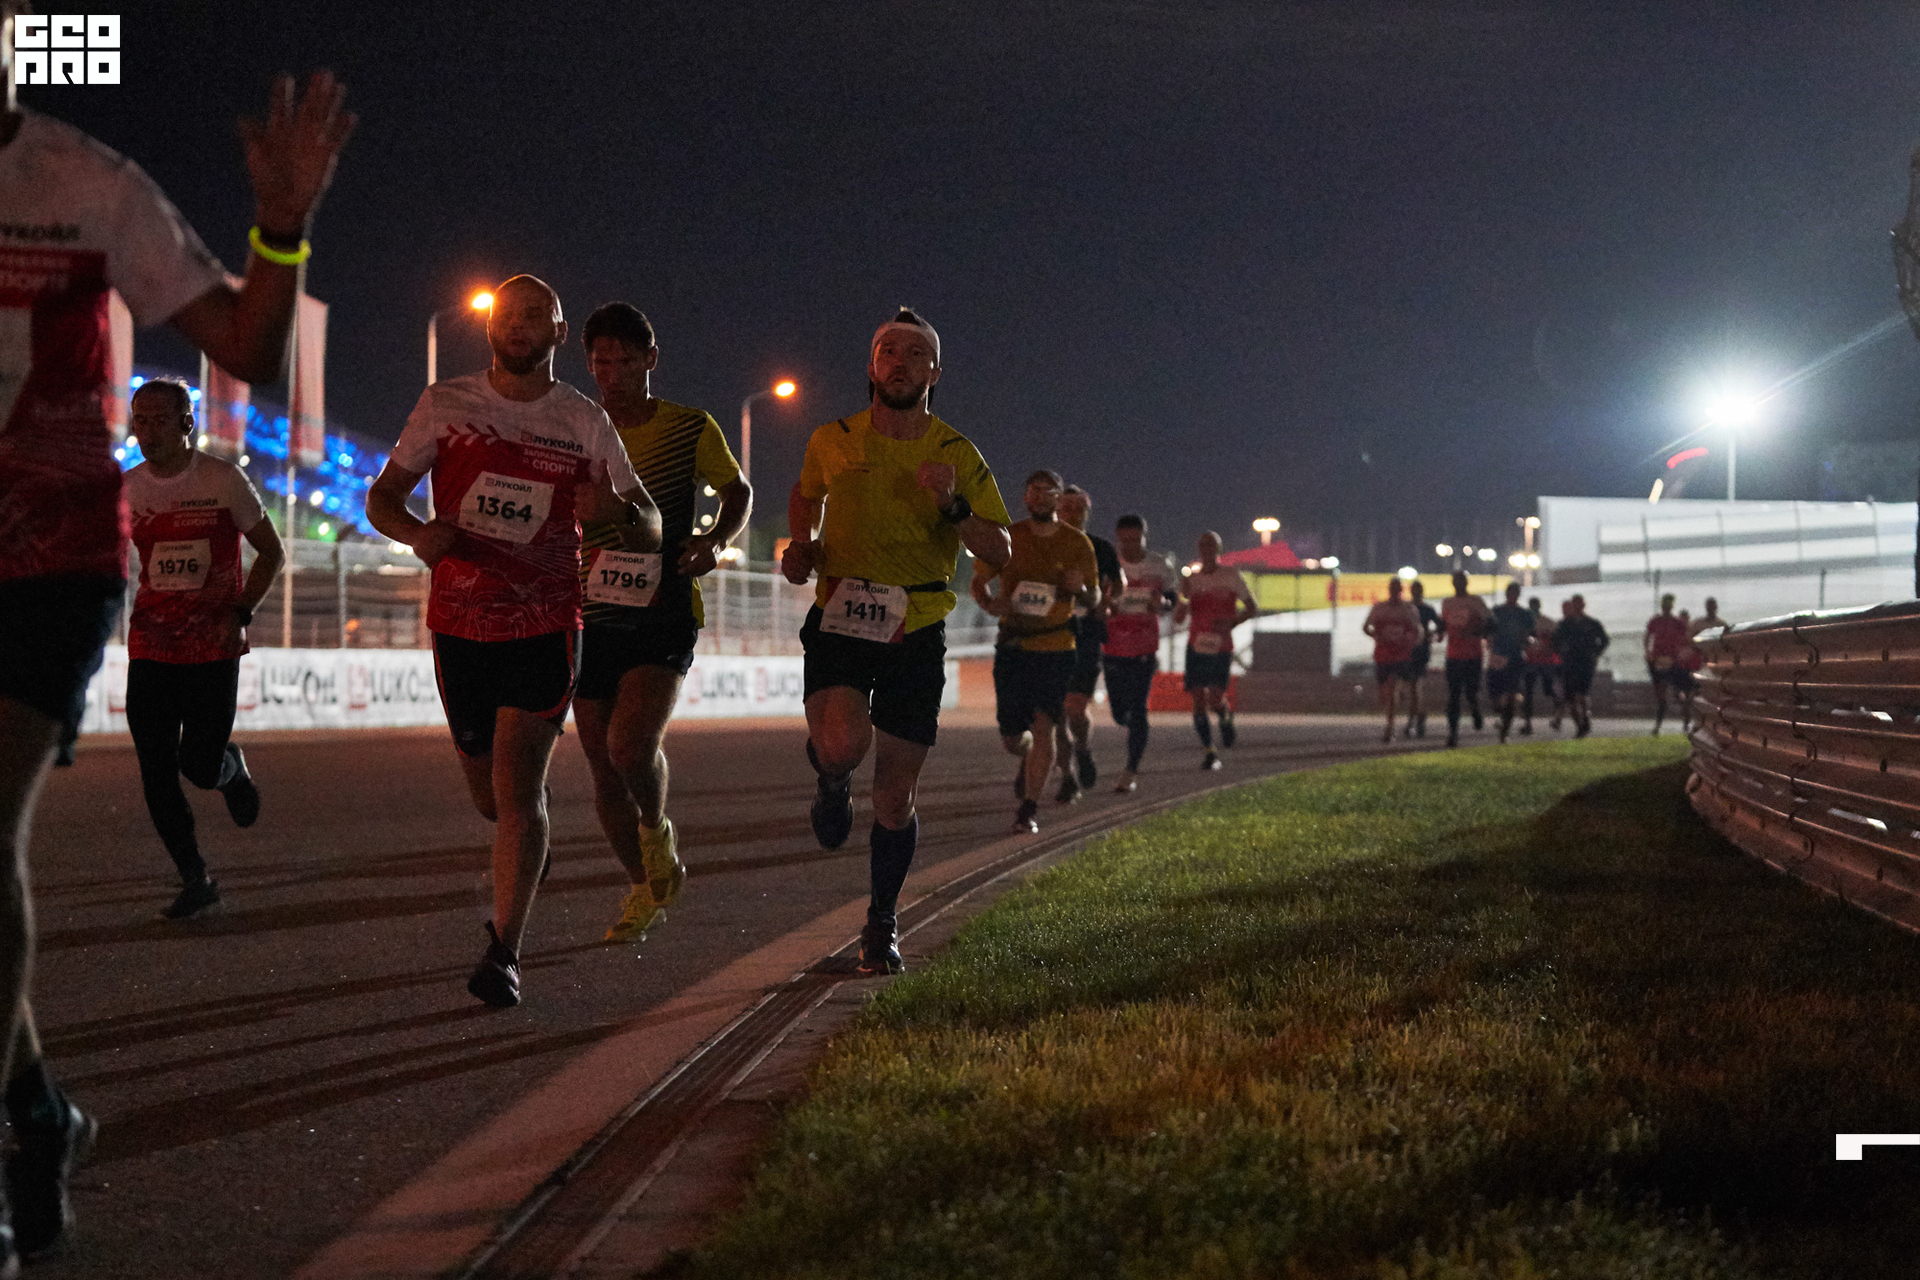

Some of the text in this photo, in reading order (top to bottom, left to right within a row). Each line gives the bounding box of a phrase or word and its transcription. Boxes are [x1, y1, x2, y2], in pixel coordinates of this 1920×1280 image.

[534, 435, 583, 454] ЛУКОЙЛ
[494, 480, 532, 493] ЛУКОЙЛ
[477, 494, 532, 522] 1364
[158, 558, 199, 574] 1976
[600, 569, 648, 589] 1796
[844, 599, 887, 622] 1411
